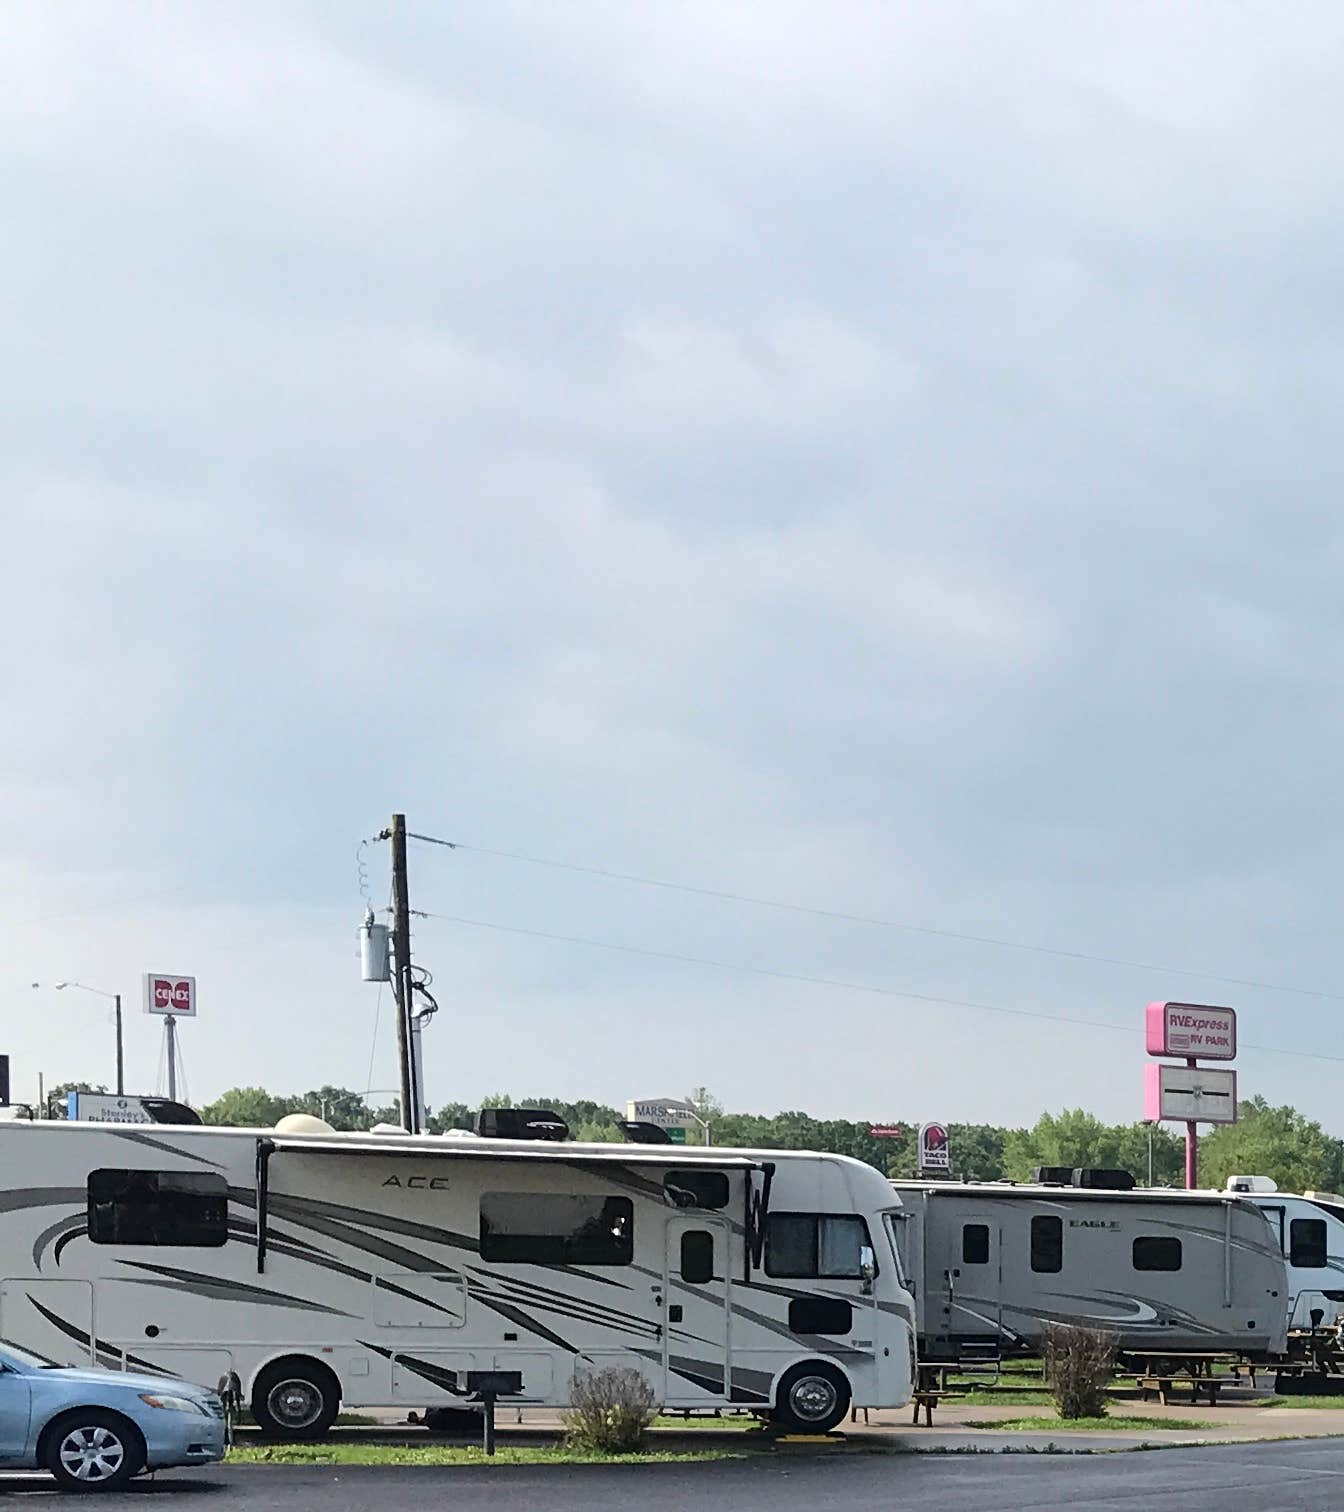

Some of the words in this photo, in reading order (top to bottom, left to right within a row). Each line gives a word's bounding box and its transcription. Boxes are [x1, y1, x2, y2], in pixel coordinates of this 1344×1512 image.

[156, 988, 189, 1001] CENEX
[1170, 1014, 1229, 1031] RVExpress
[1190, 1034, 1203, 1044] RV
[1205, 1035, 1229, 1047] PARK
[923, 1151, 947, 1159] TACO
[382, 1174, 450, 1191] ACE
